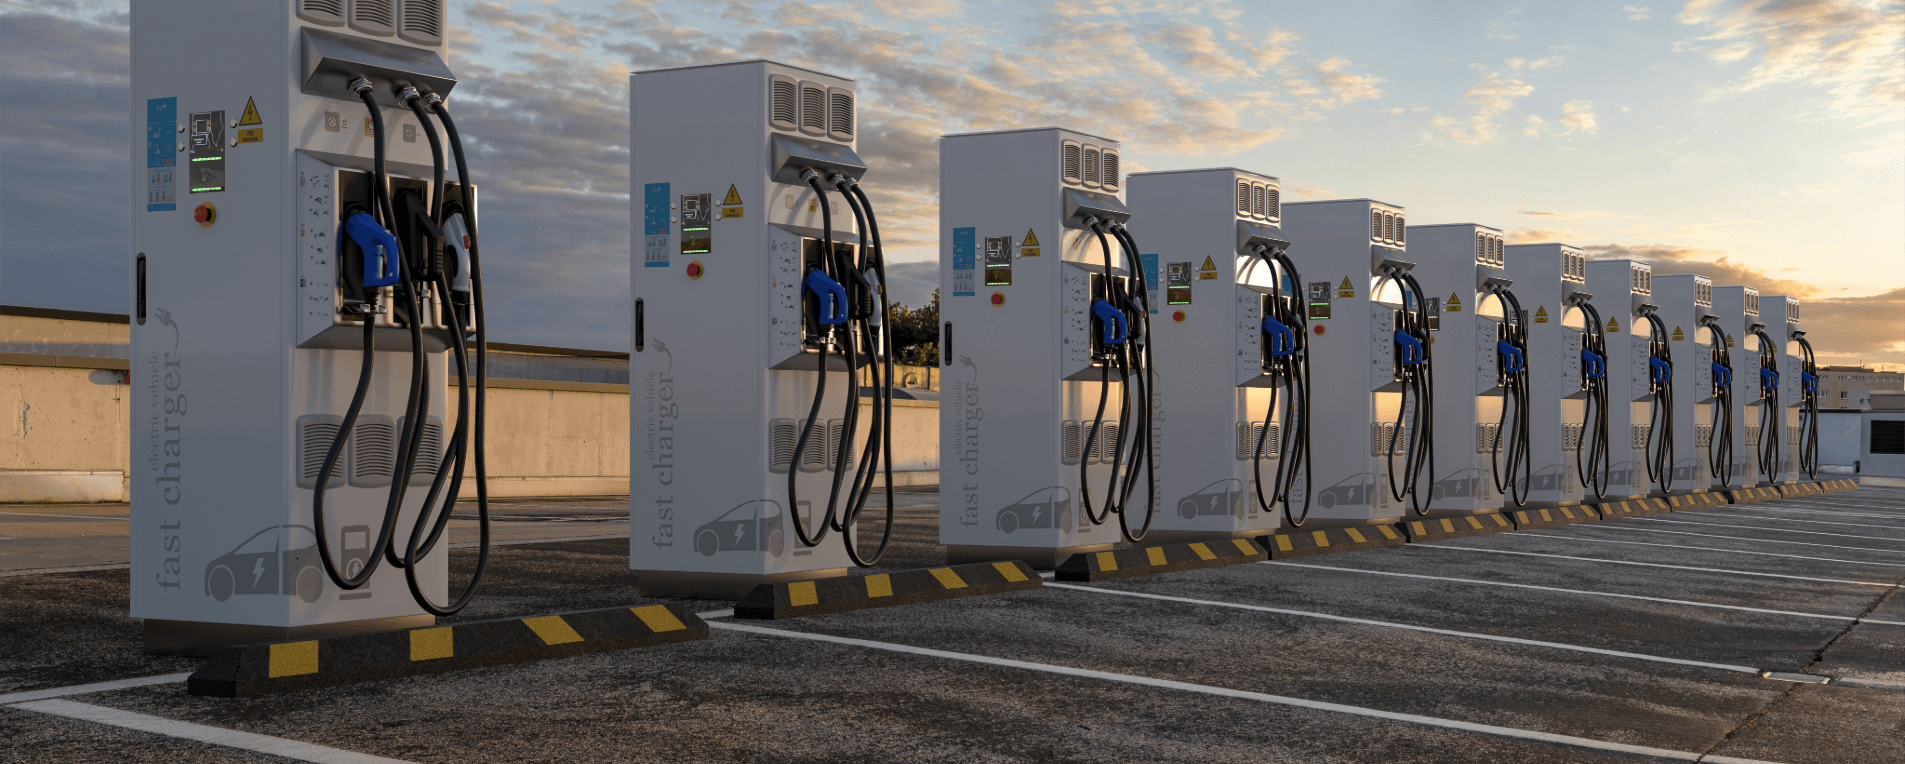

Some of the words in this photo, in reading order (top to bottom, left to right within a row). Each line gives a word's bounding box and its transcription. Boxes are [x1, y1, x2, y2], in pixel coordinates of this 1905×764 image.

[149, 351, 160, 409] vehicle
[645, 370, 655, 413] vehicle
[953, 381, 962, 416] vehicle
[149, 412, 160, 471] electric
[156, 352, 188, 506] charger
[645, 416, 655, 461] electric
[652, 372, 679, 486] charger
[953, 418, 962, 455] electric
[959, 382, 984, 476] charger
[651, 495, 674, 550] fast
[959, 482, 979, 528] fast
[156, 518, 181, 591] fast
